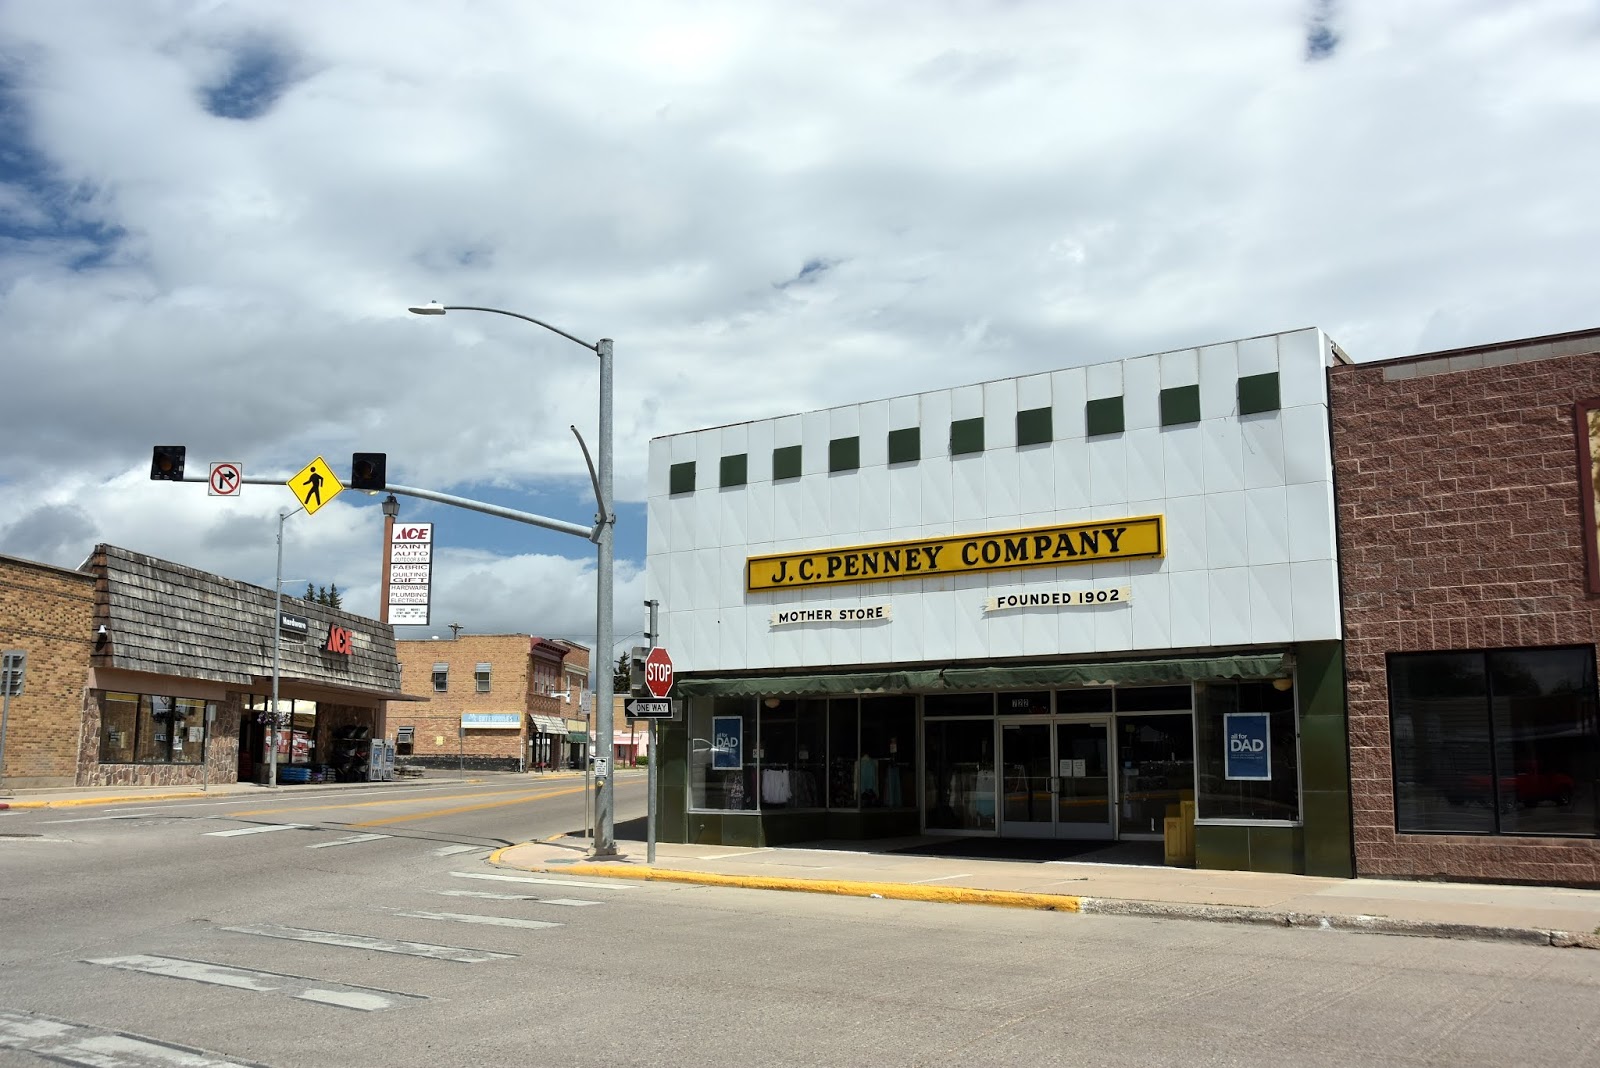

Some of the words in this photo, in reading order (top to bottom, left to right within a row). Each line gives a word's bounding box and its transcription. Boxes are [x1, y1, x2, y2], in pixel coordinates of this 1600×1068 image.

[395, 527, 429, 540] ACE
[961, 527, 1127, 566] COMPANY
[997, 592, 1072, 608] FOUNDED
[1079, 589, 1120, 604] 1902
[778, 609, 833, 623] MOTHER
[839, 606, 884, 620] STORE
[282, 616, 307, 630] Hardware
[327, 624, 353, 655] ACE
[647, 662, 672, 682] STOP
[636, 703, 650, 712] ONE
[652, 703, 667, 712] WAY
[716, 737, 739, 748] DAD
[1230, 739, 1265, 752] DAD
